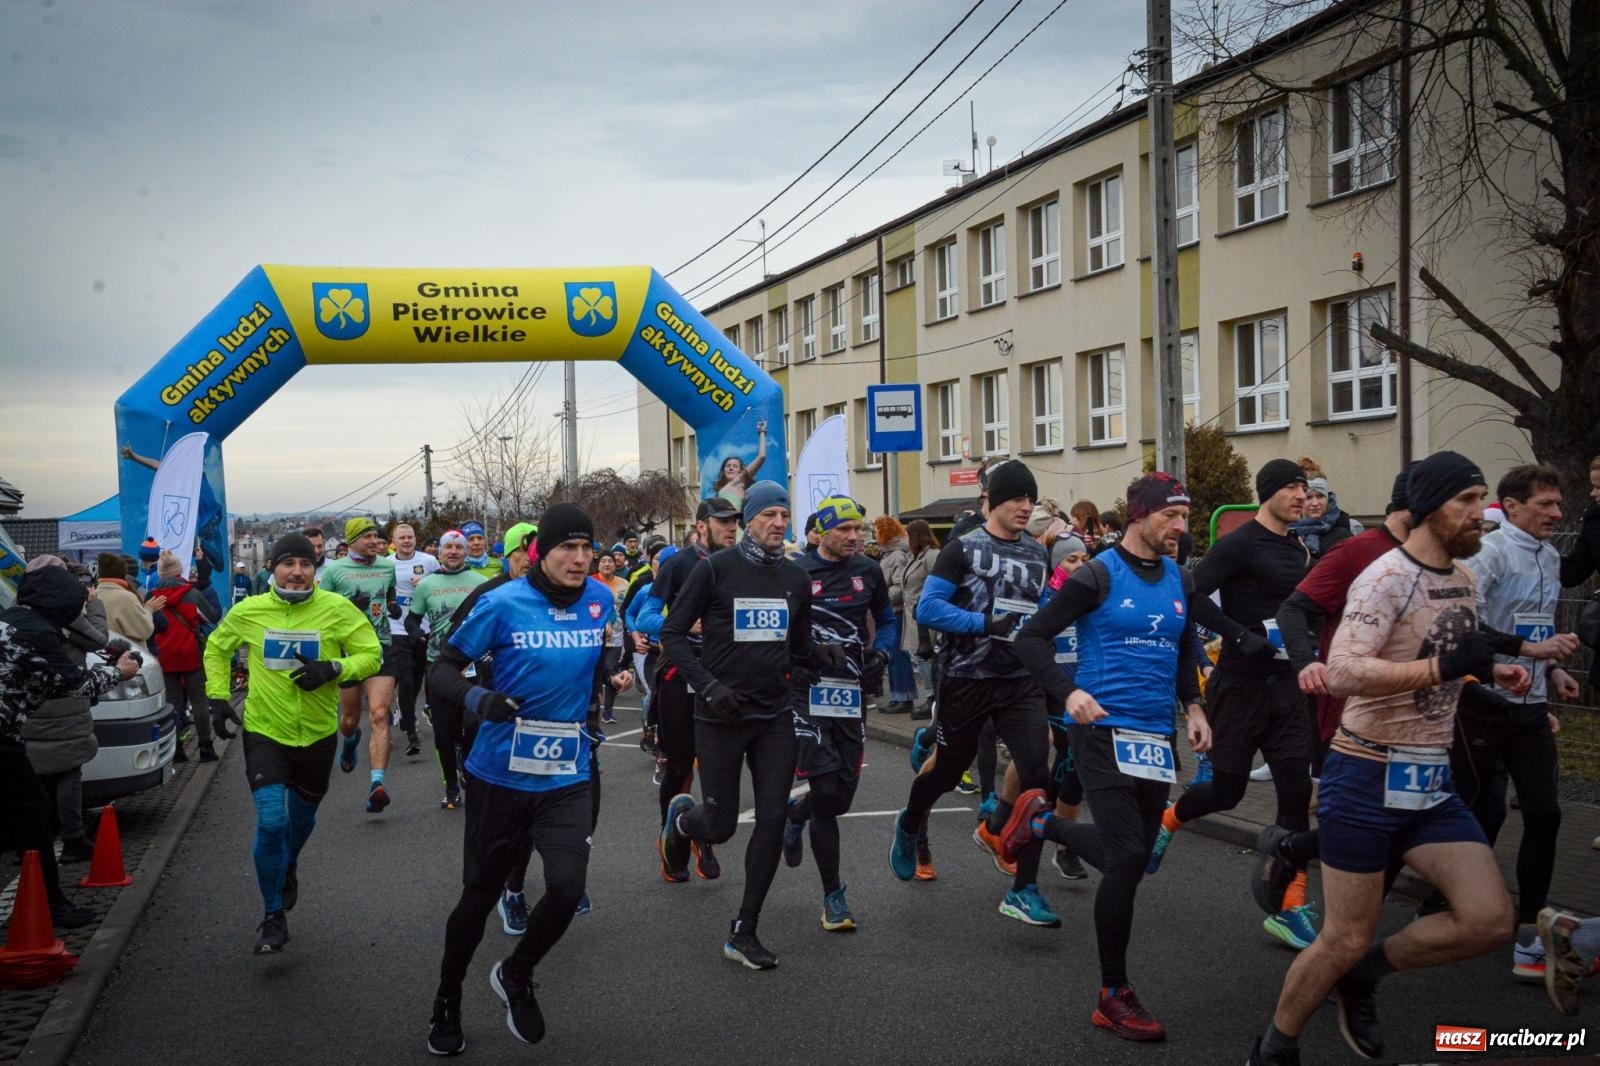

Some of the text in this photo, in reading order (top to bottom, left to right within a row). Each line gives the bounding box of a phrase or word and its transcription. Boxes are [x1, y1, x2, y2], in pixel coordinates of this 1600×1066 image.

[417, 282, 519, 298] Gmina
[392, 302, 547, 321] Pietrowice
[413, 325, 527, 343] Wielkie
[161, 302, 272, 405] Gmina ludzi
[656, 301, 756, 396] Gmina ludzi
[188, 328, 291, 424] aktywnych
[640, 325, 735, 412] aktywnych
[745, 610, 780, 628] 188
[511, 628, 604, 649] RUNNER
[279, 641, 301, 658] 71
[820, 688, 853, 706] 163
[533, 737, 563, 759] 66
[1126, 743, 1166, 766] 148
[1404, 765, 1443, 791] 116
